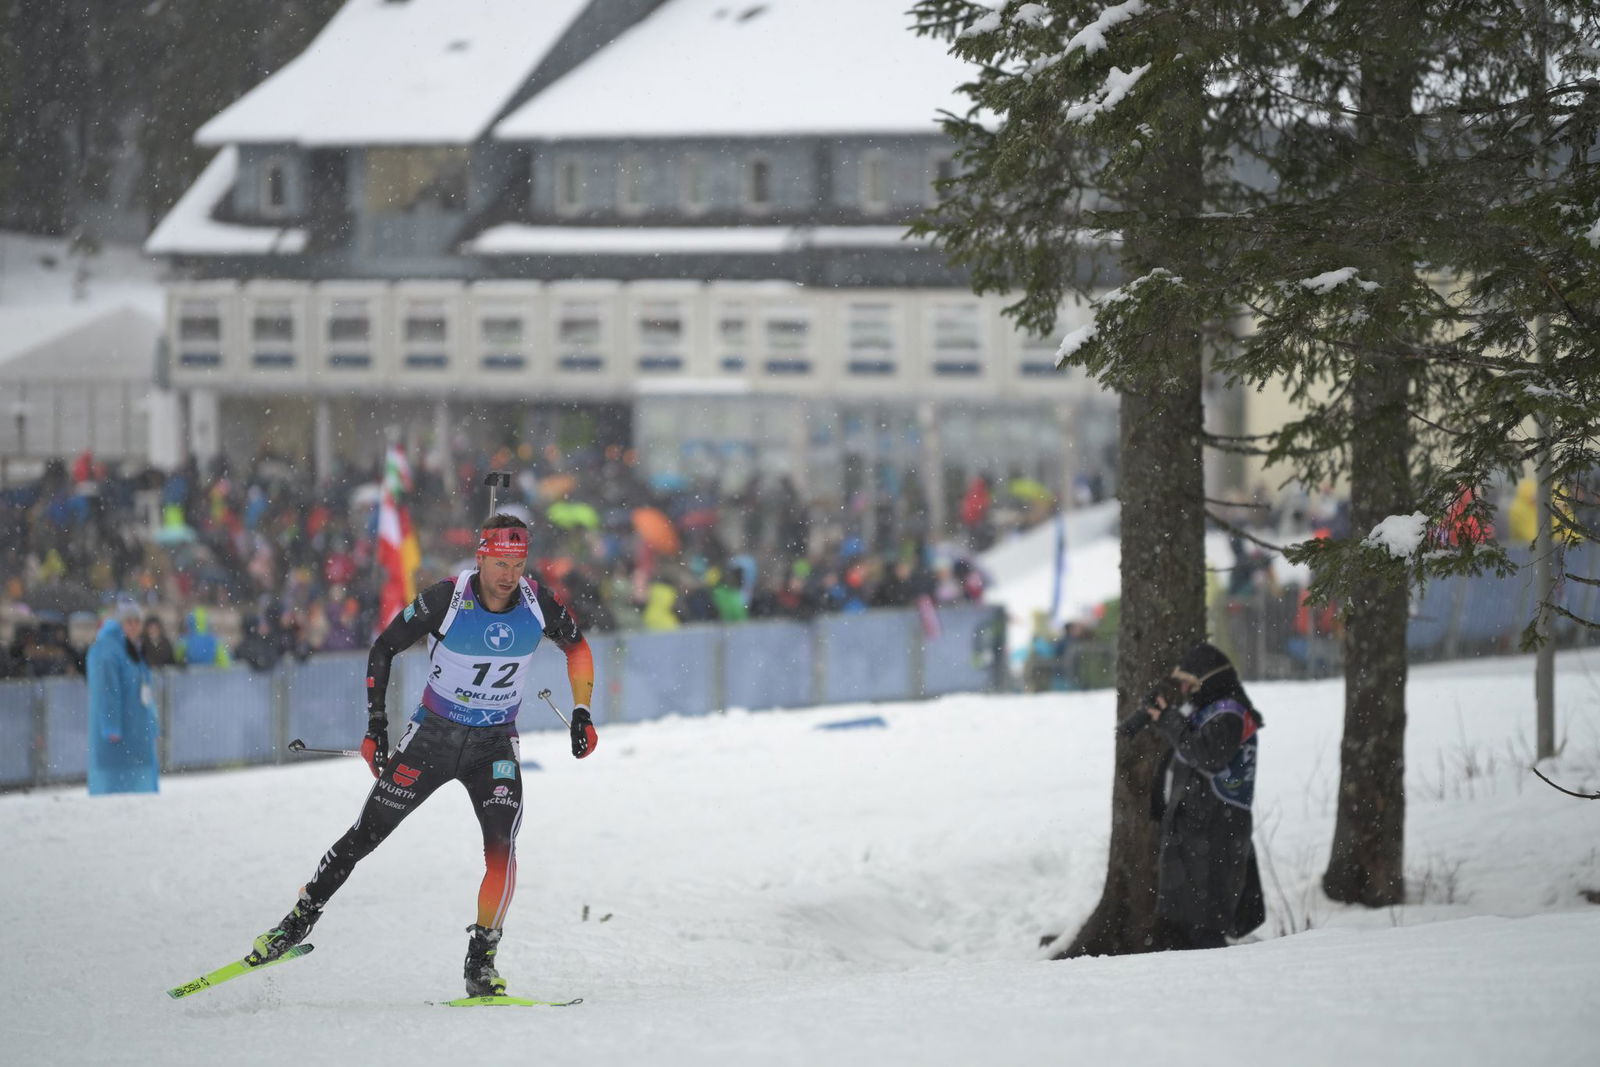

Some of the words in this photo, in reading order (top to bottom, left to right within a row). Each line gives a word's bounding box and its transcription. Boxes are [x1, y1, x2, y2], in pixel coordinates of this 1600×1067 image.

[450, 591, 461, 610] JOKA
[522, 586, 535, 604] JOKA
[472, 663, 520, 688] 12
[454, 687, 517, 702] POKLJUKA
[448, 711, 472, 723] NEW
[477, 710, 508, 725] X3
[498, 762, 512, 775] TQ
[379, 780, 416, 799] WÜRTH
[381, 798, 407, 809] TERREX
